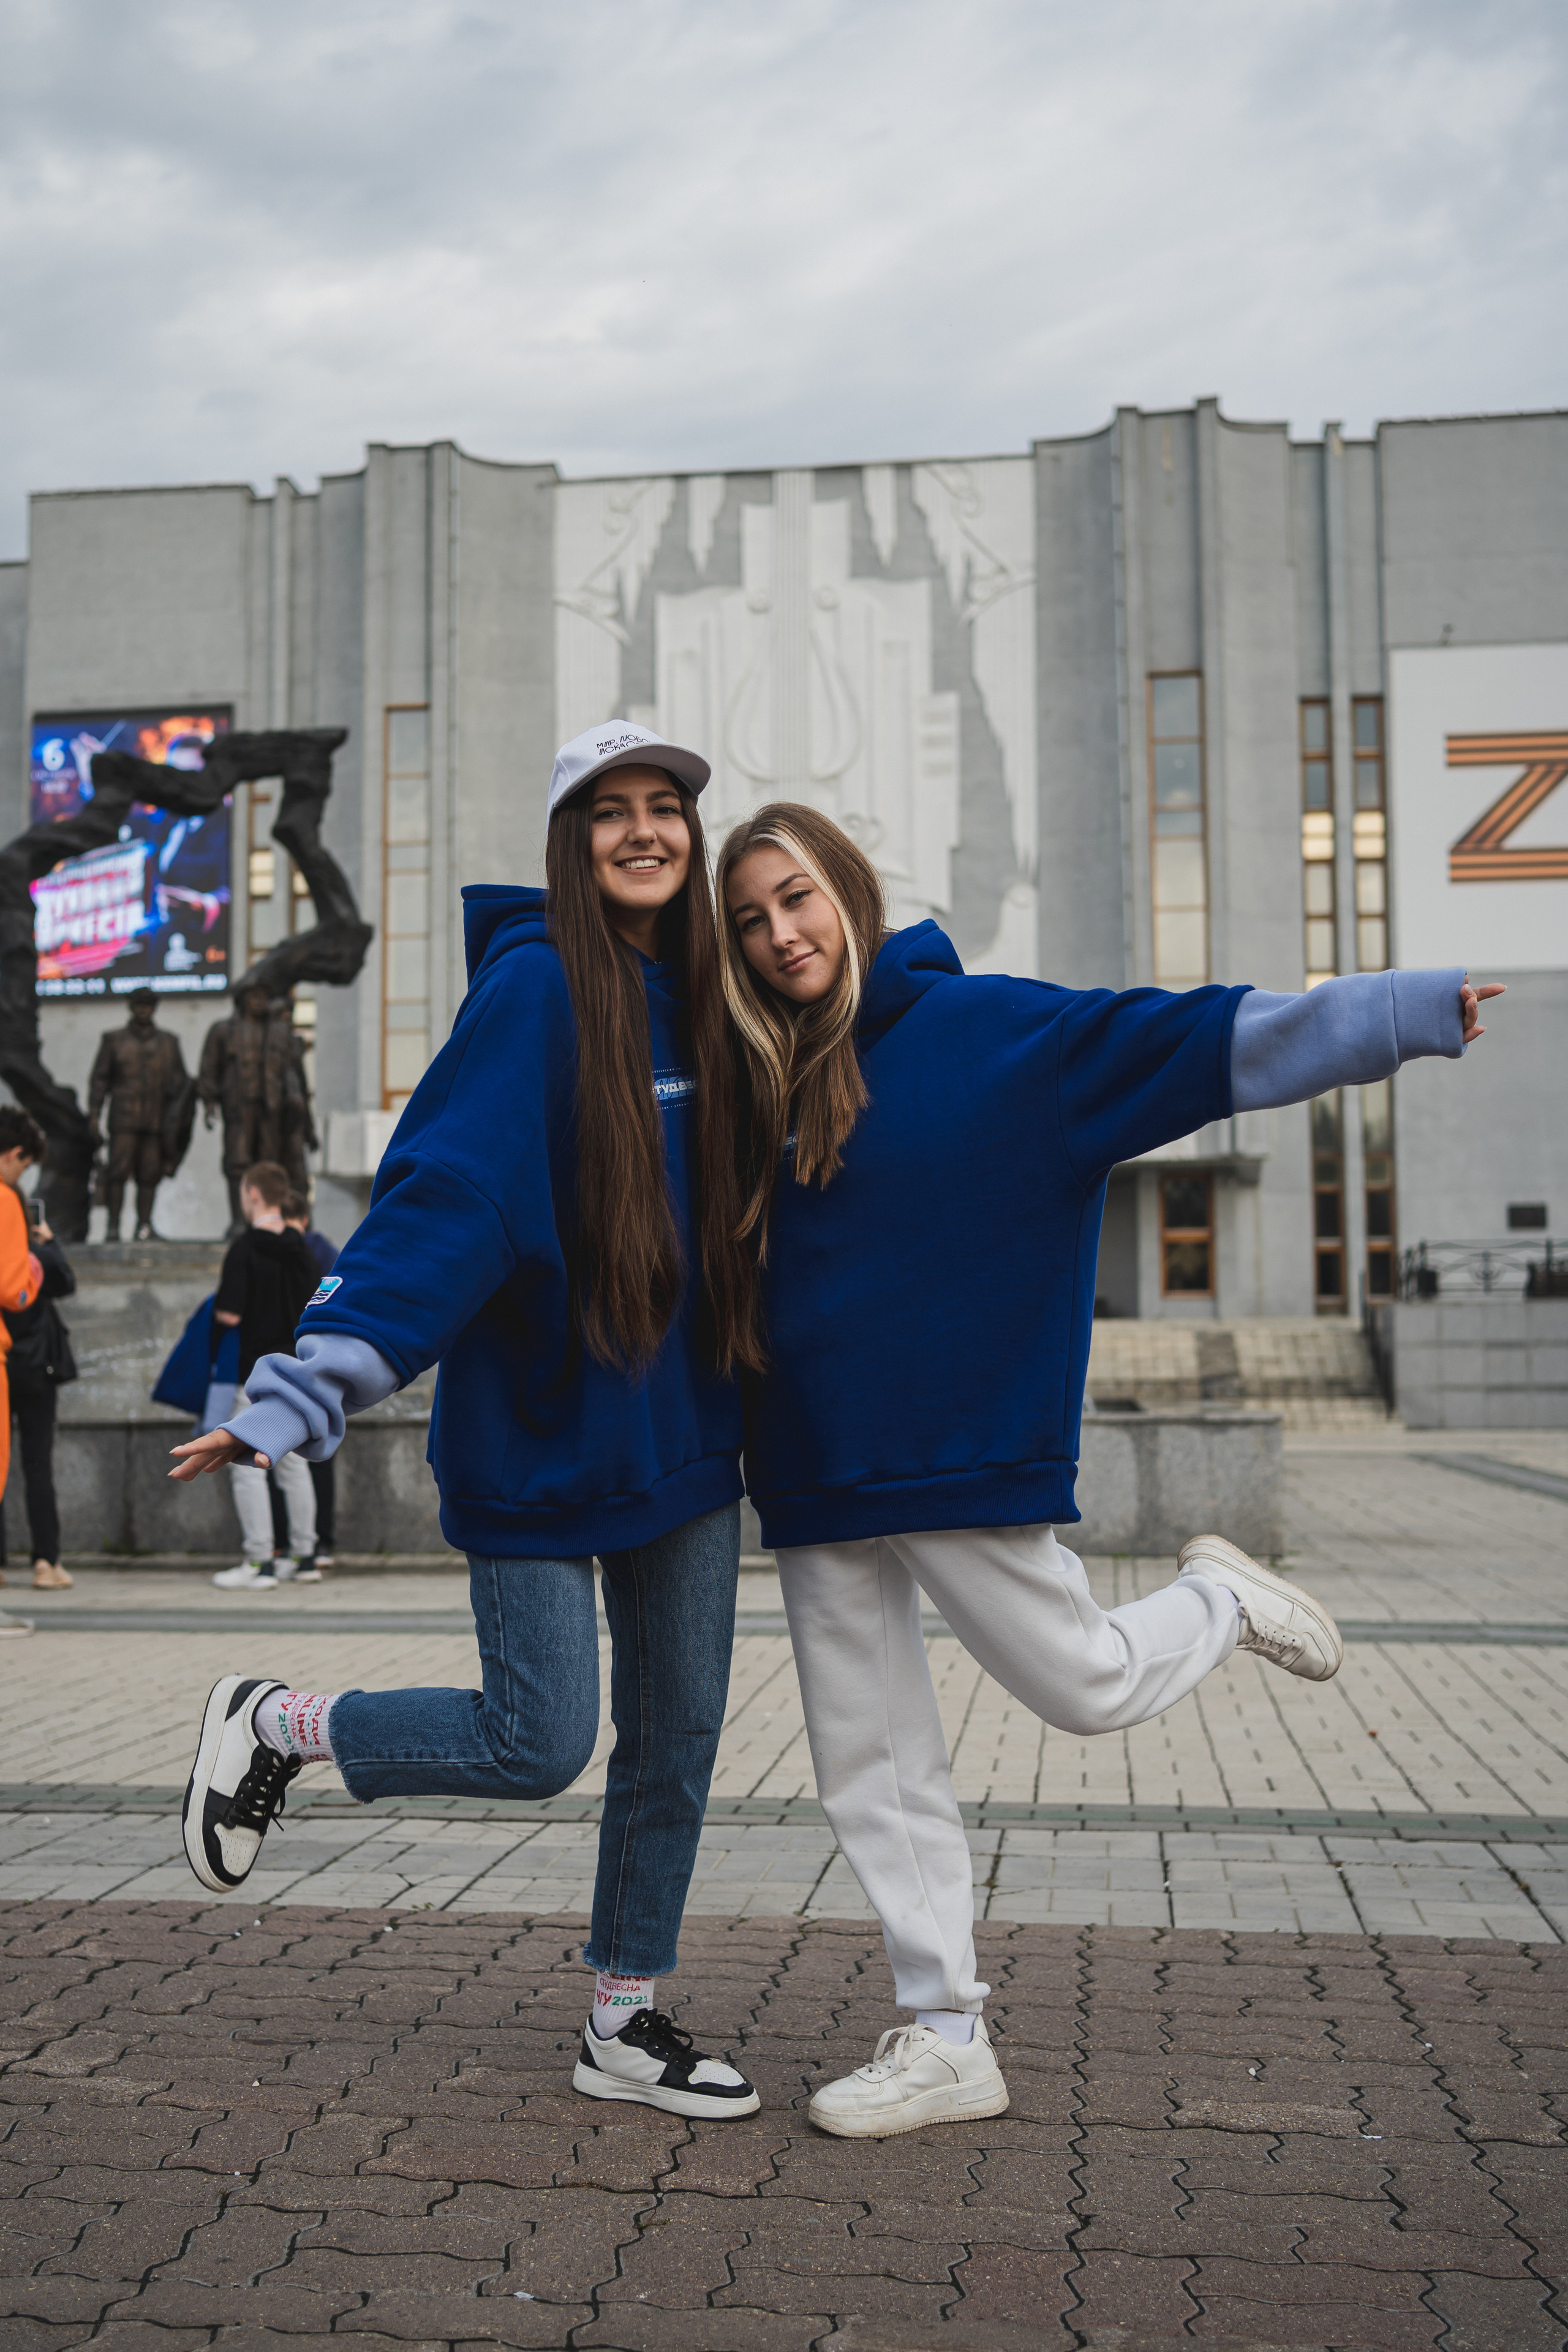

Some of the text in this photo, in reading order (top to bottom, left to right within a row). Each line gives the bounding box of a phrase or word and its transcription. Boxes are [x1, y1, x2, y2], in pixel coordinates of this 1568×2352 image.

[620, 734, 650, 743] ЛЮБО
[42, 737, 64, 771] 6
[1446, 728, 1568, 883] Z
[652, 1080, 696, 1095] ТУДВЕ
[600, 1977, 641, 1991] СТУДВЕСНА
[597, 1989, 612, 2007] ЧГУ
